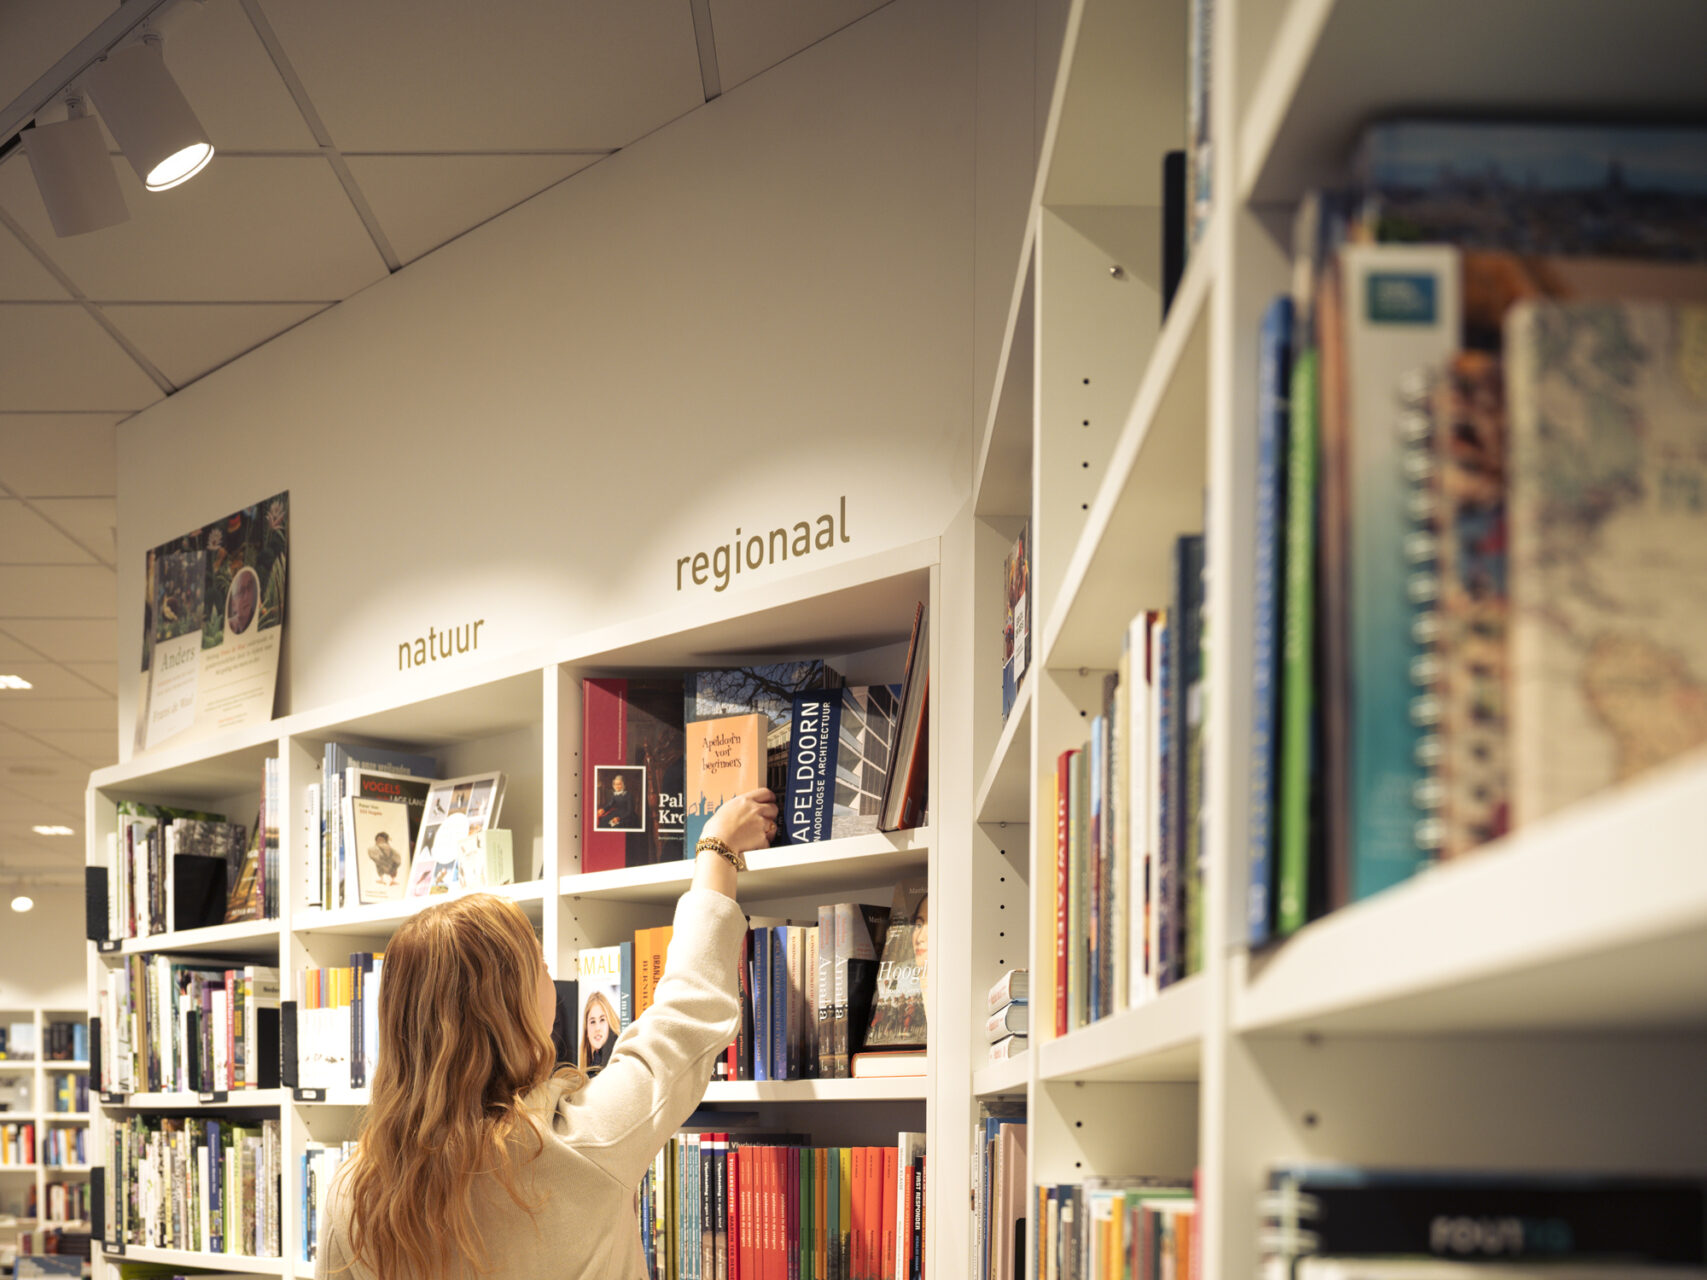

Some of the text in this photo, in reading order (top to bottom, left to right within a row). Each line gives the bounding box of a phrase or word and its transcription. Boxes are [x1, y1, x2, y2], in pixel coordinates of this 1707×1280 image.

[676, 495, 850, 593] regionaal
[160, 646, 196, 672] Anders
[398, 617, 485, 671] natuur
[702, 733, 741, 749] Apeldoorn
[702, 757, 742, 774] beginners
[818, 701, 831, 776] ARCHITECTUUR
[362, 779, 401, 796] VOGELS
[792, 702, 820, 842] APELDOORN
[818, 956, 831, 1021] Amalia
[835, 955, 848, 1020] Amalia
